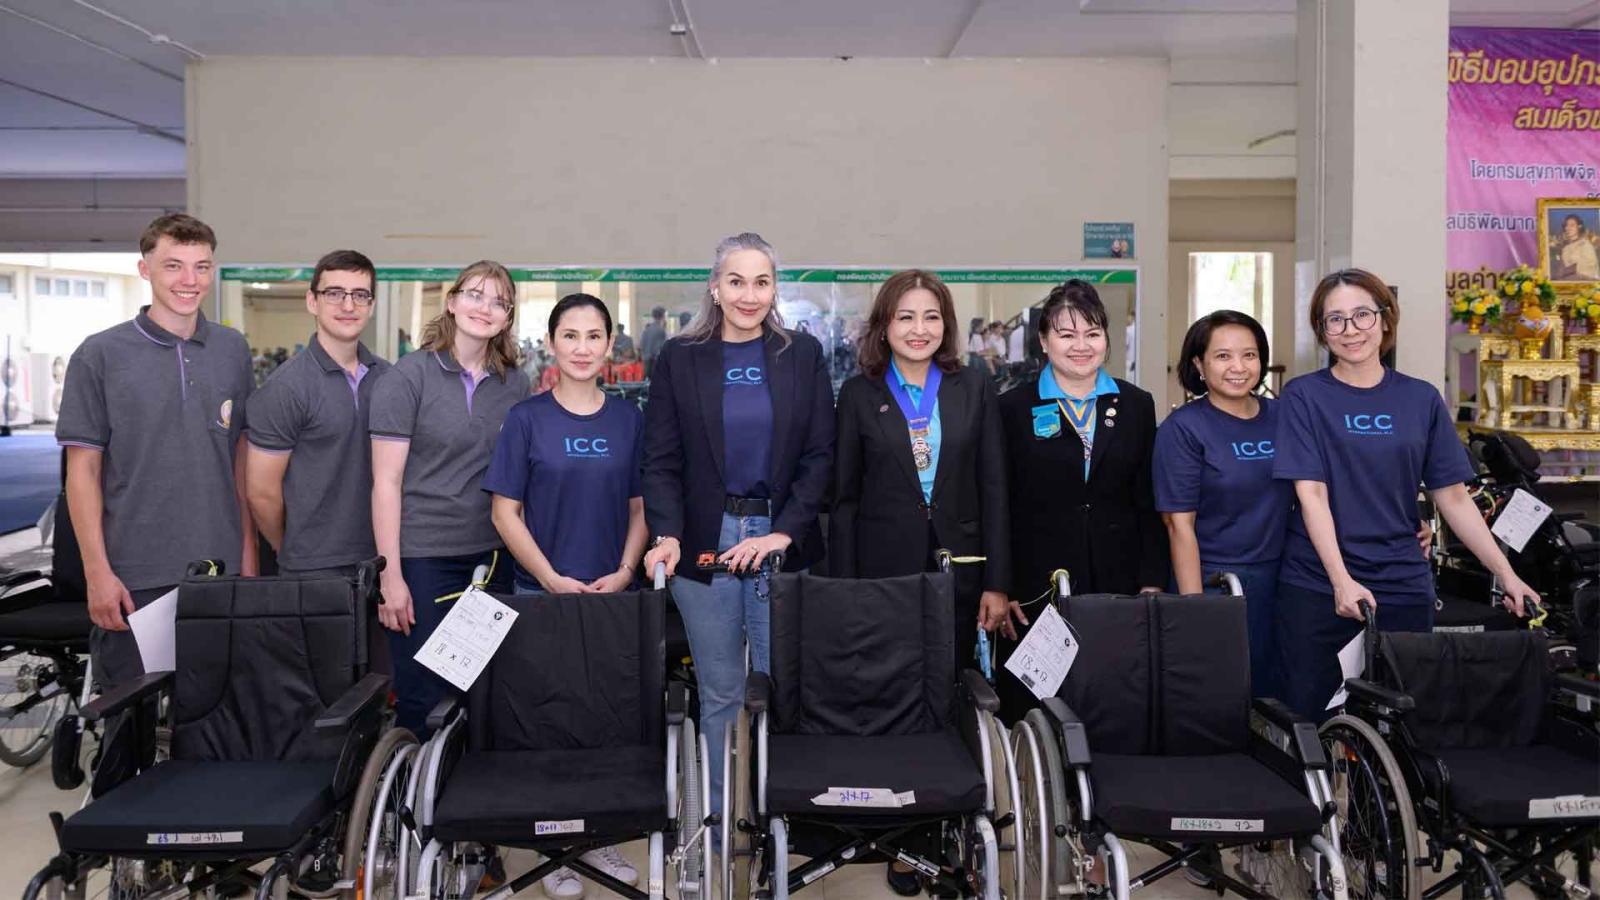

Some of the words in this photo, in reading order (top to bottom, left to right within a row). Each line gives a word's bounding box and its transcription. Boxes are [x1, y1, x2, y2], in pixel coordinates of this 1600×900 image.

[726, 367, 762, 381] CC
[1344, 414, 1393, 430] ICC
[564, 437, 609, 453] ICC
[1231, 440, 1275, 456] ICC
